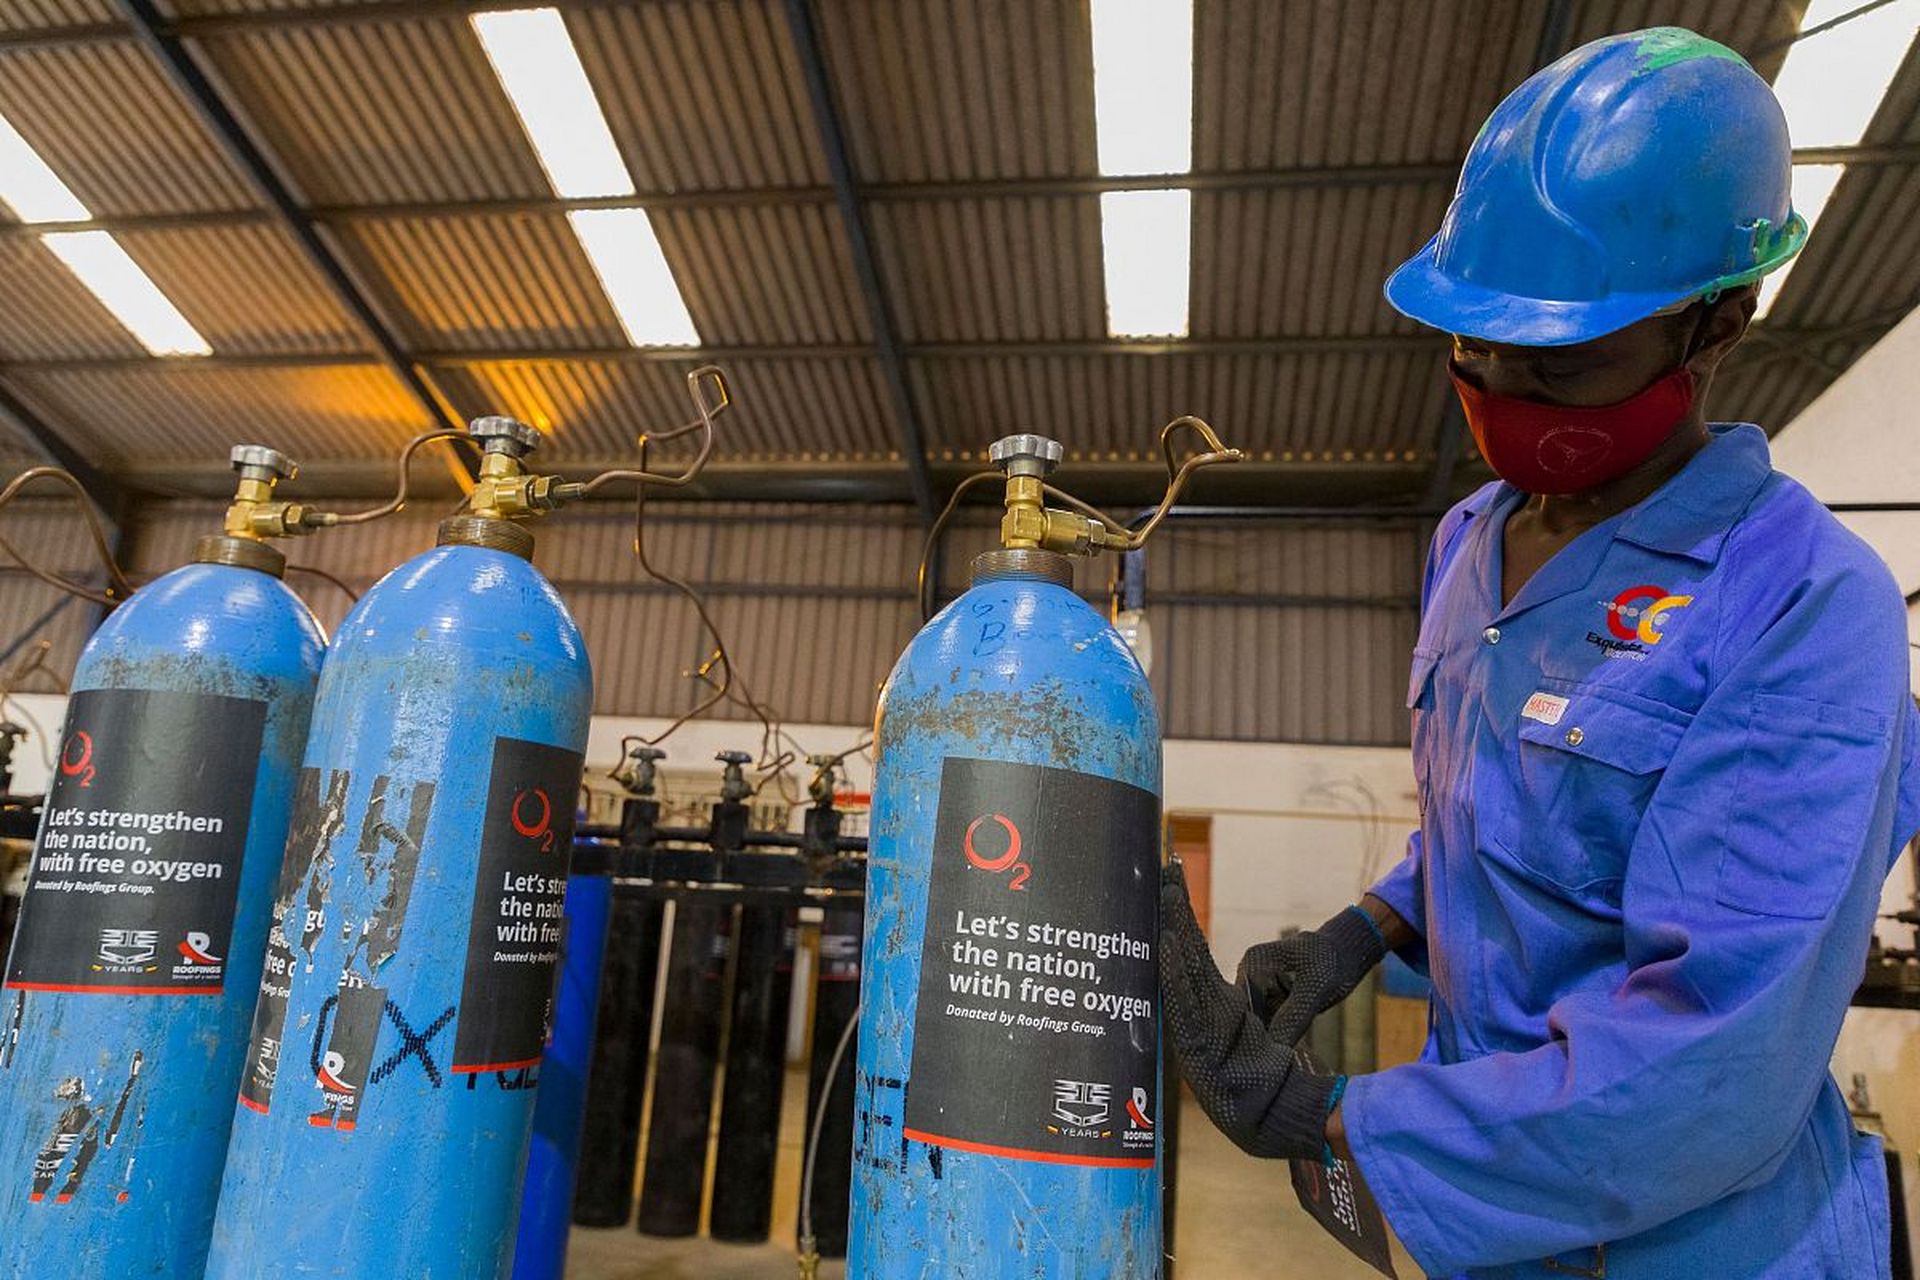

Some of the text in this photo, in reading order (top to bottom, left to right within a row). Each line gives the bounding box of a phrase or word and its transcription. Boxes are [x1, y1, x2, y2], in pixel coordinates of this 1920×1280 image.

[49, 808, 223, 833] Let's strengthen
[44, 830, 152, 854] the nation,
[39, 853, 222, 882] with free oxygen
[74, 881, 117, 894] Roofings
[118, 882, 154, 895] Group.
[504, 872, 545, 894] Let's
[500, 895, 533, 918] the
[497, 921, 537, 942] with
[956, 910, 1150, 961] Let's strengthen
[104, 965, 143, 973] YEARS
[172, 965, 222, 974] ROOFINGS
[952, 940, 1101, 985] the nation,
[949, 970, 1151, 1022] with free oxygen
[946, 1003, 1107, 1038] Donated by Roofings Group.
[1061, 1127, 1100, 1139] YEARS
